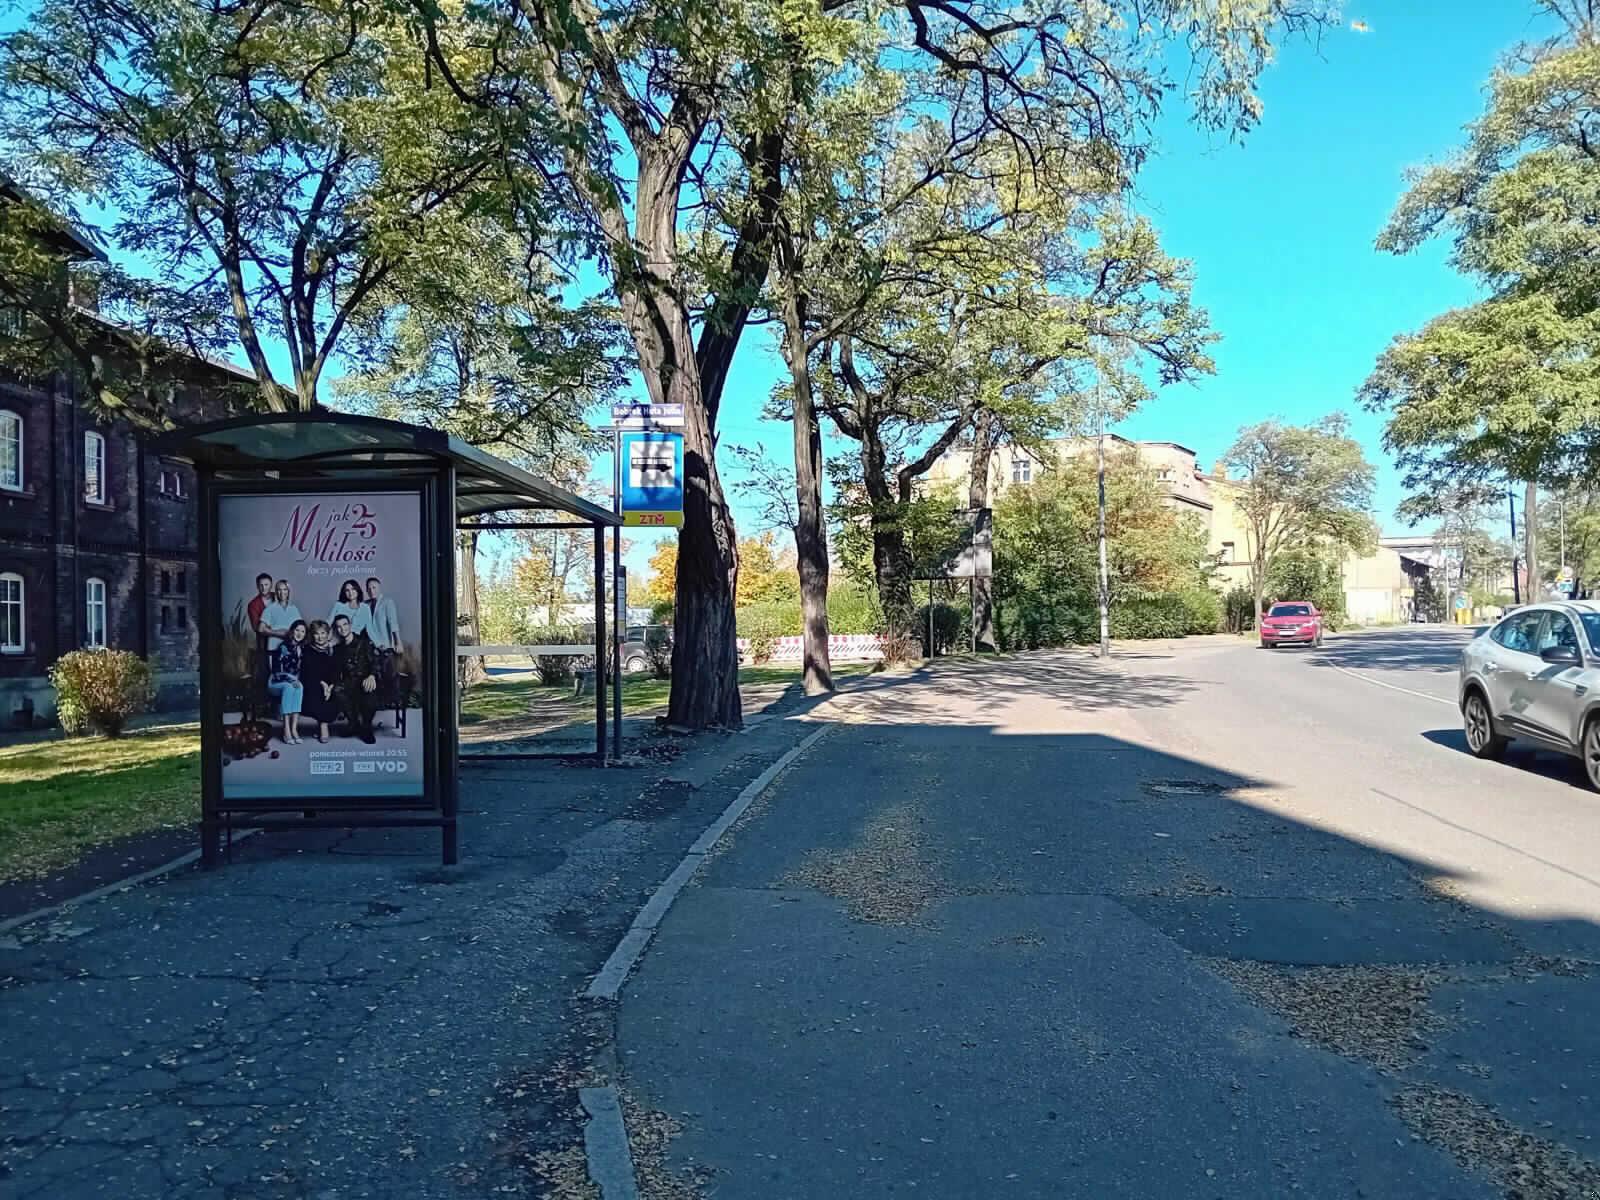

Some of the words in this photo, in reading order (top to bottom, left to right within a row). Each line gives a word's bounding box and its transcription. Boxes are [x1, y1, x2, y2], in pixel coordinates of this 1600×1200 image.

[264, 503, 320, 552] M
[326, 504, 350, 528] jak
[352, 503, 376, 540] 25
[640, 513, 665, 525] ZTM
[296, 527, 376, 562] Miłość
[376, 761, 408, 773] VOD
